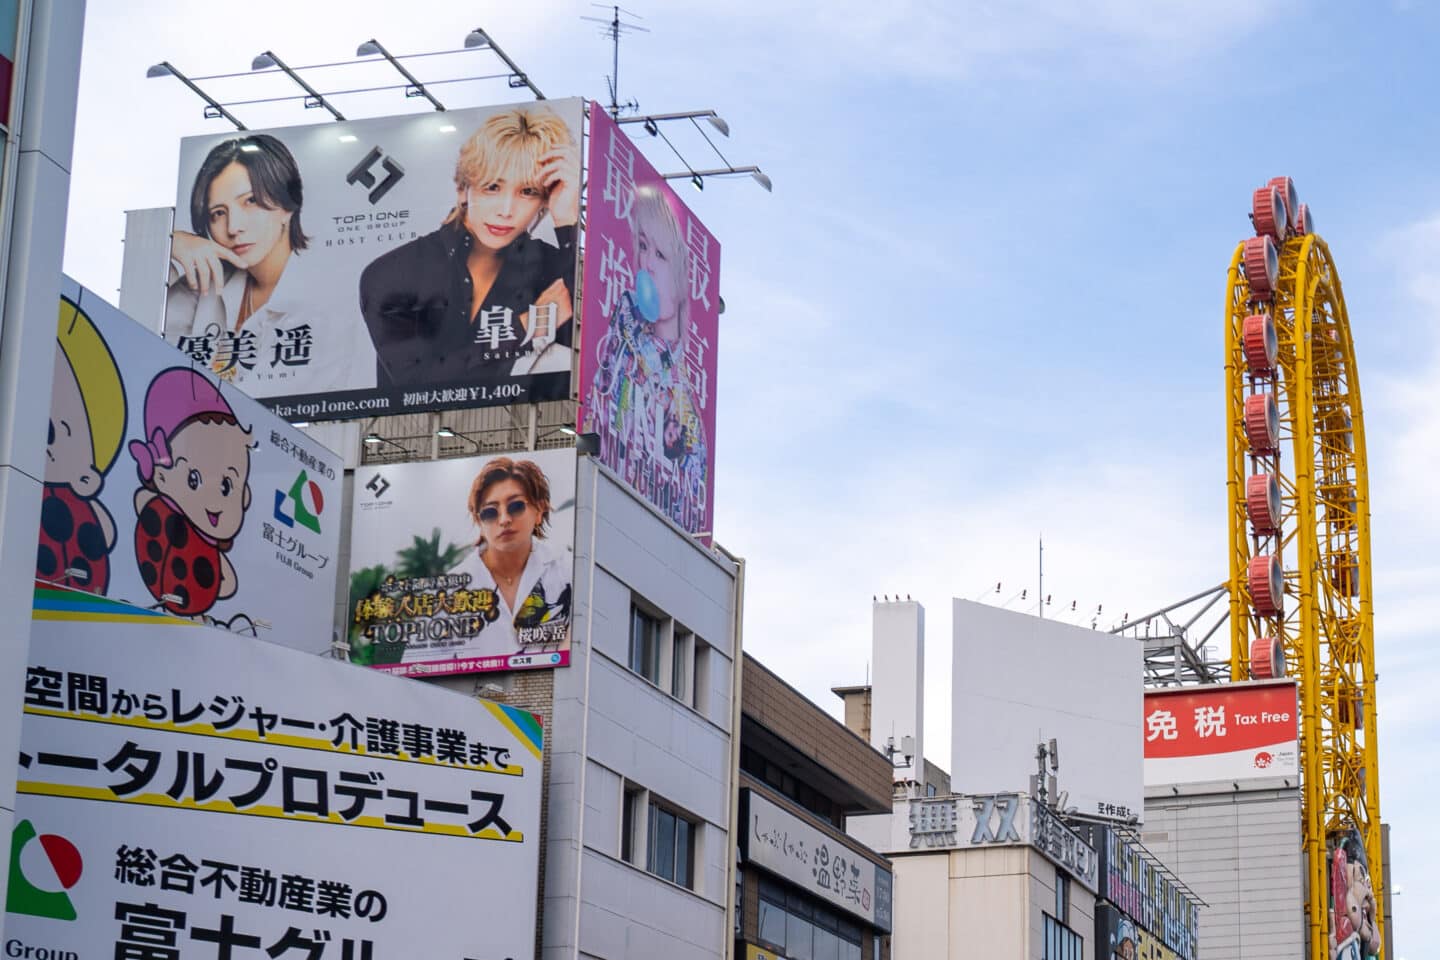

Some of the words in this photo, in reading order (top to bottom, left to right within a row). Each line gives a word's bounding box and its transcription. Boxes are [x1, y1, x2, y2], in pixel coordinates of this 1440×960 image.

[325, 236, 365, 247] HOST
[377, 231, 417, 242] CLUB
[600, 126, 638, 318] 最強
[474, 302, 558, 350] 皐月
[686, 215, 710, 410] 最高
[270, 430, 336, 481] 総合不動産業の
[262, 522, 330, 569] 富士グループ
[276, 551, 293, 568] FUJI
[293, 561, 314, 580] Group
[1235, 713, 1257, 726] Tax
[1261, 710, 1290, 723] Free
[18, 741, 514, 836] ータルプロデュース
[114, 844, 388, 922] 総合不動産業の
